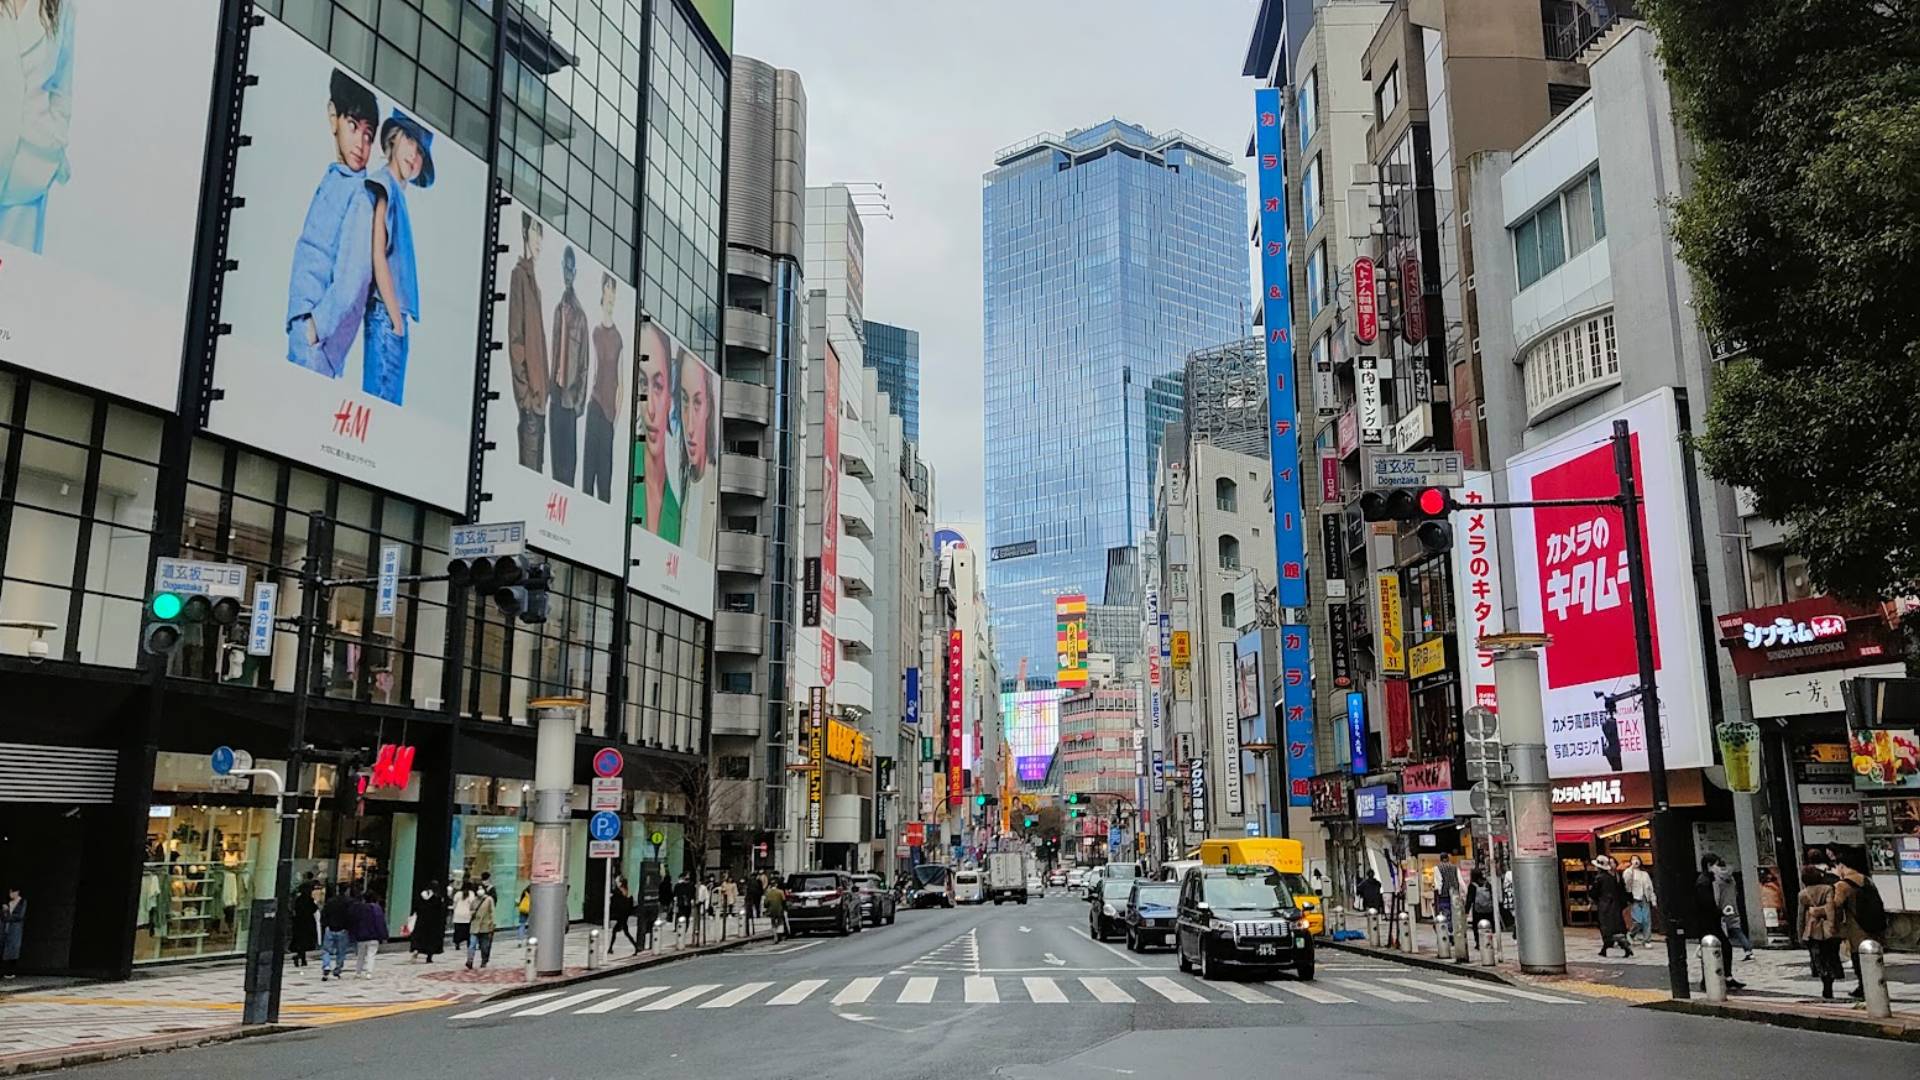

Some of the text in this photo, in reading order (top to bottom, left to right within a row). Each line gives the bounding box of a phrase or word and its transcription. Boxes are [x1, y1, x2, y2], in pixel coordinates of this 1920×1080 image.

[1361, 371, 1376, 426] 肉ギャング
[333, 399, 371, 443] H&M
[1375, 457, 1458, 475] 道玄坂二丁目
[1378, 475, 1427, 486] Dogenzaka 2
[545, 492, 569, 526] H&M
[454, 526, 521, 545] 道玄坂二丁目
[1546, 516, 1610, 567] カメラの
[162, 563, 241, 585] 道玄坂二丁目
[1150, 655, 1160, 685] LABI
[1286, 634, 1311, 797] カラオケ館
[1618, 720, 1640, 737] TAX
[1226, 710, 1239, 804] intimissimi
[1619, 736, 1642, 753] FREE
[370, 744, 416, 791] H&M
[1154, 763, 1163, 791] LABI
